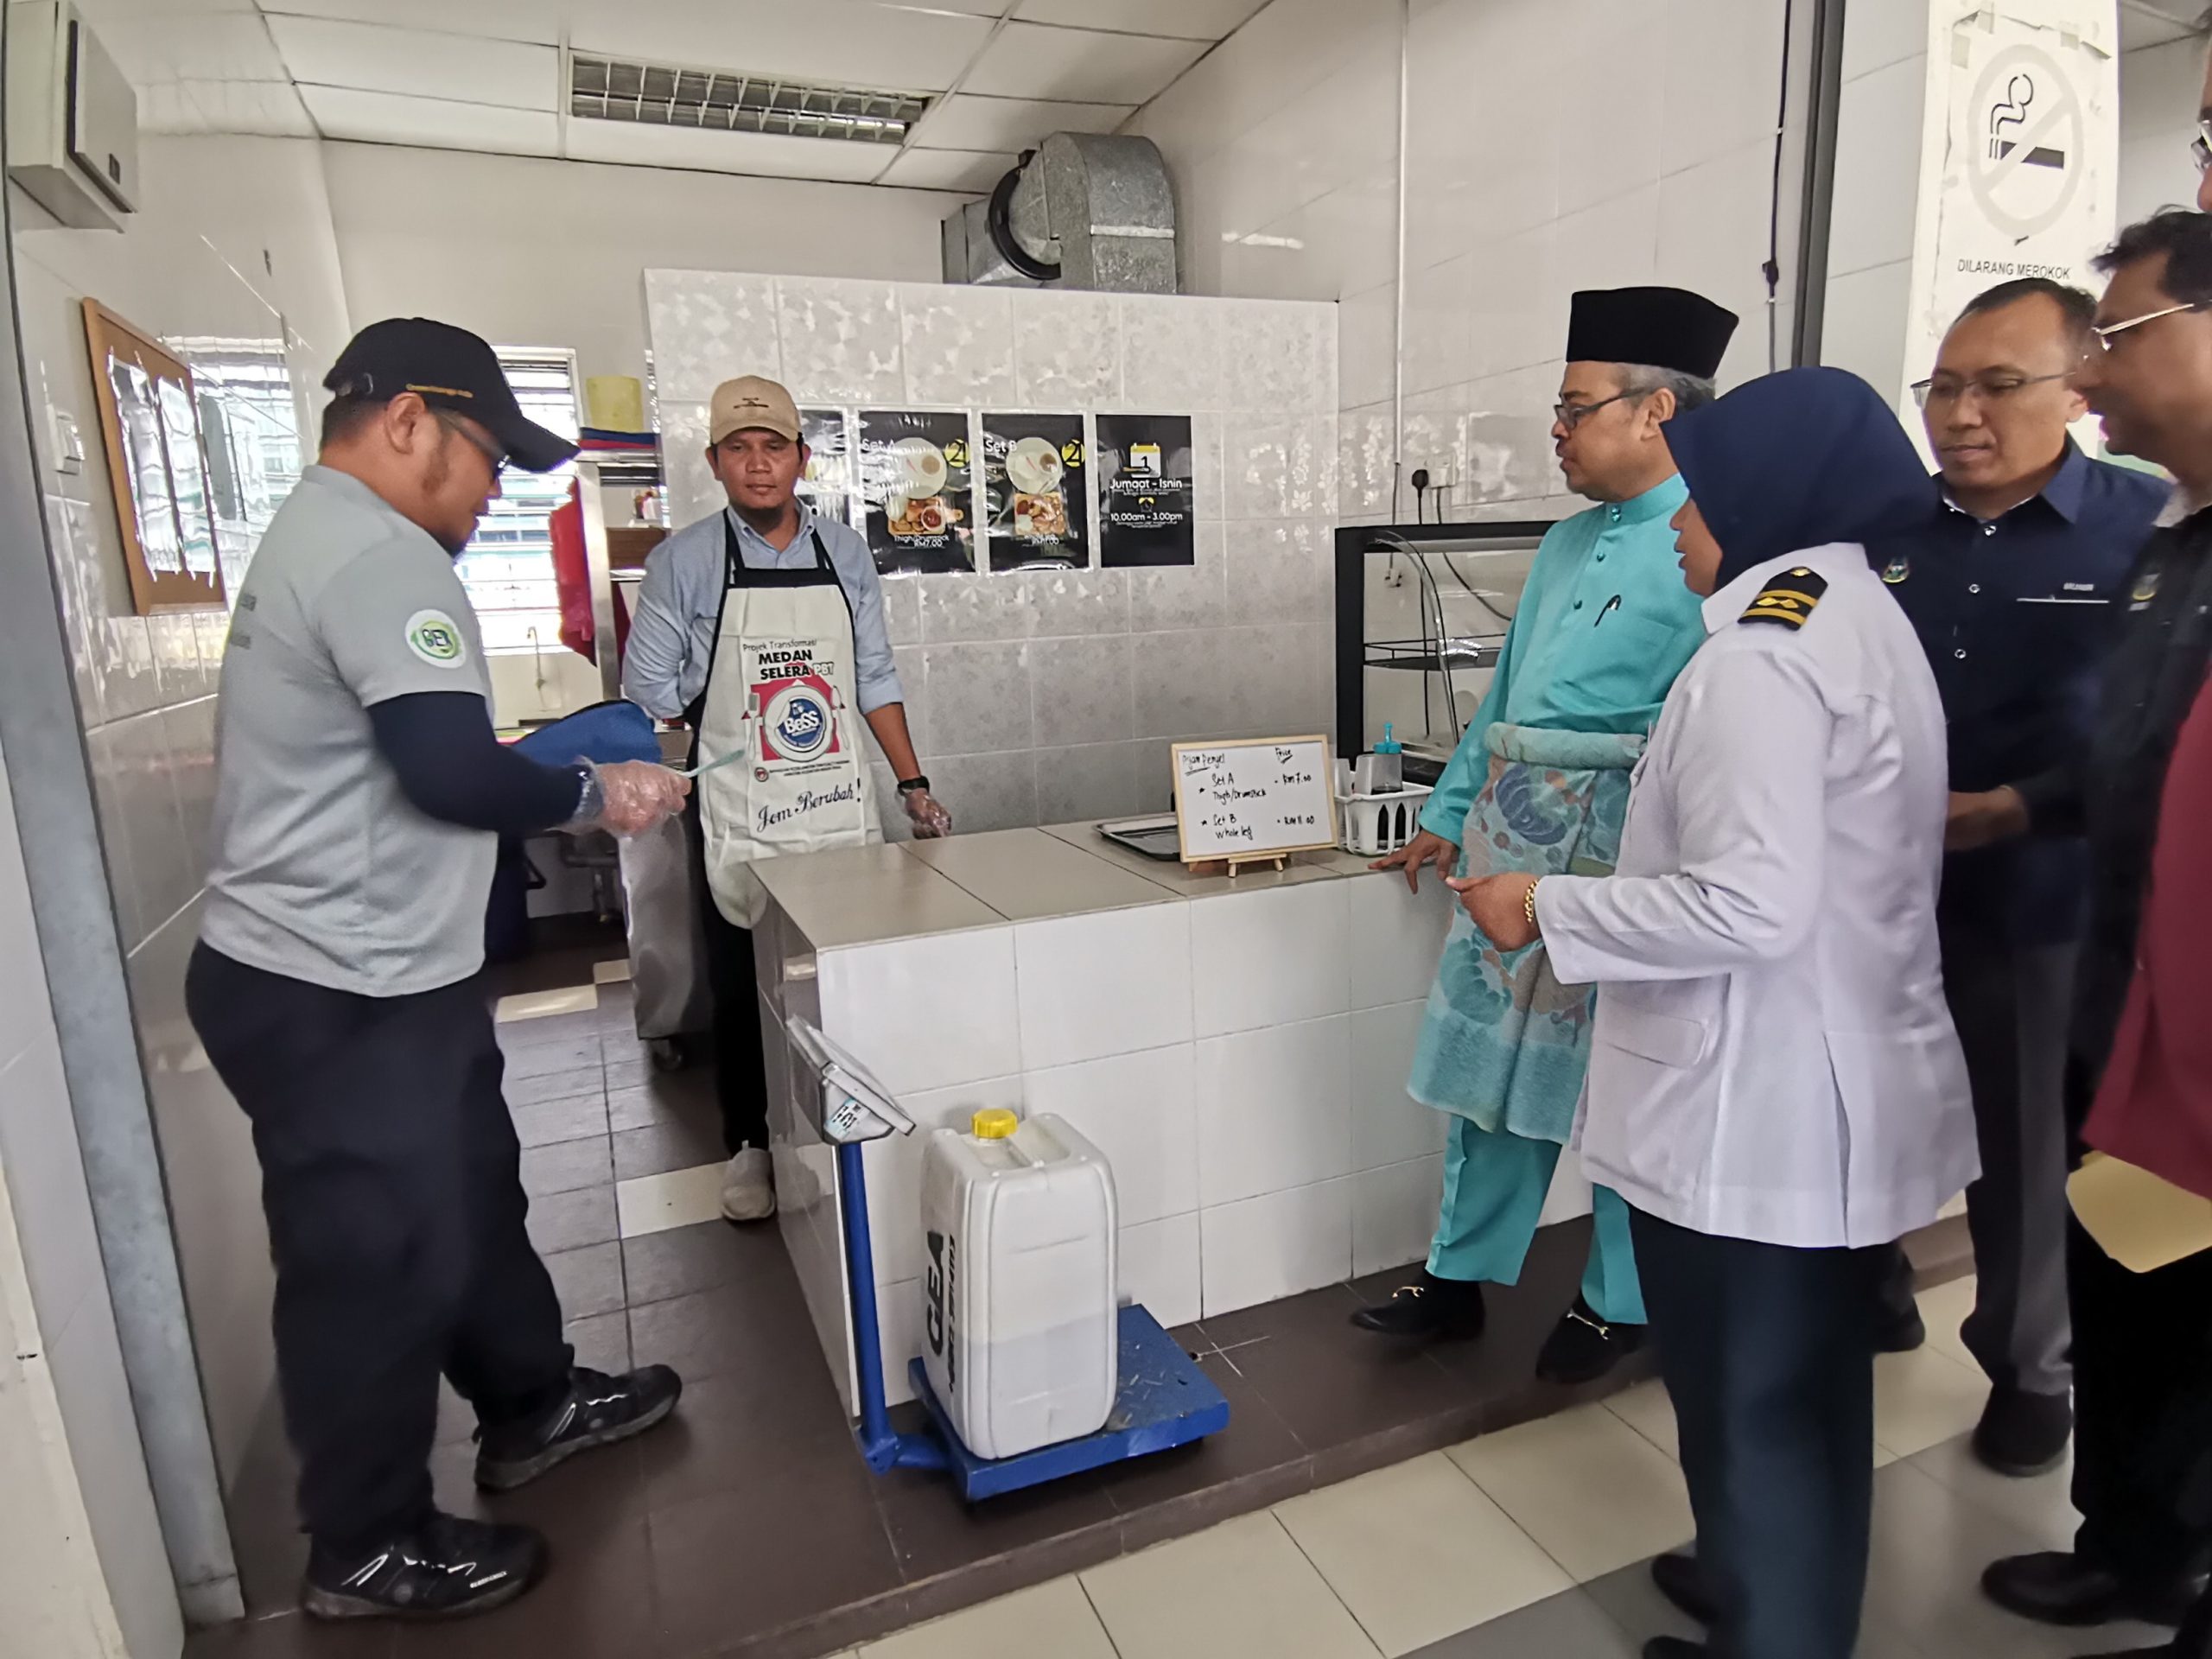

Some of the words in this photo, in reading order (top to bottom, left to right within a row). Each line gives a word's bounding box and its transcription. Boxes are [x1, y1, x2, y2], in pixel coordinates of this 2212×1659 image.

[1957, 258, 2013, 276] DILARANG
[2016, 264, 2072, 279] MEROKOK
[861, 438, 883, 450] Set
[985, 441, 1007, 452] Set
[1109, 478, 1150, 489] Jumaat
[1159, 478, 1183, 489] Isnin
[1110, 512, 1145, 521] 10.00am
[1153, 512, 1183, 521] 3.00pm
[743, 643, 766, 652] Projek
[758, 649, 813, 664] MEDAN
[760, 664, 811, 680] SELERA
[812, 661, 835, 674] PBT
[1228, 772, 1234, 785] A
[757, 804, 792, 833] Jom
[926, 1230, 944, 1357] GEA
